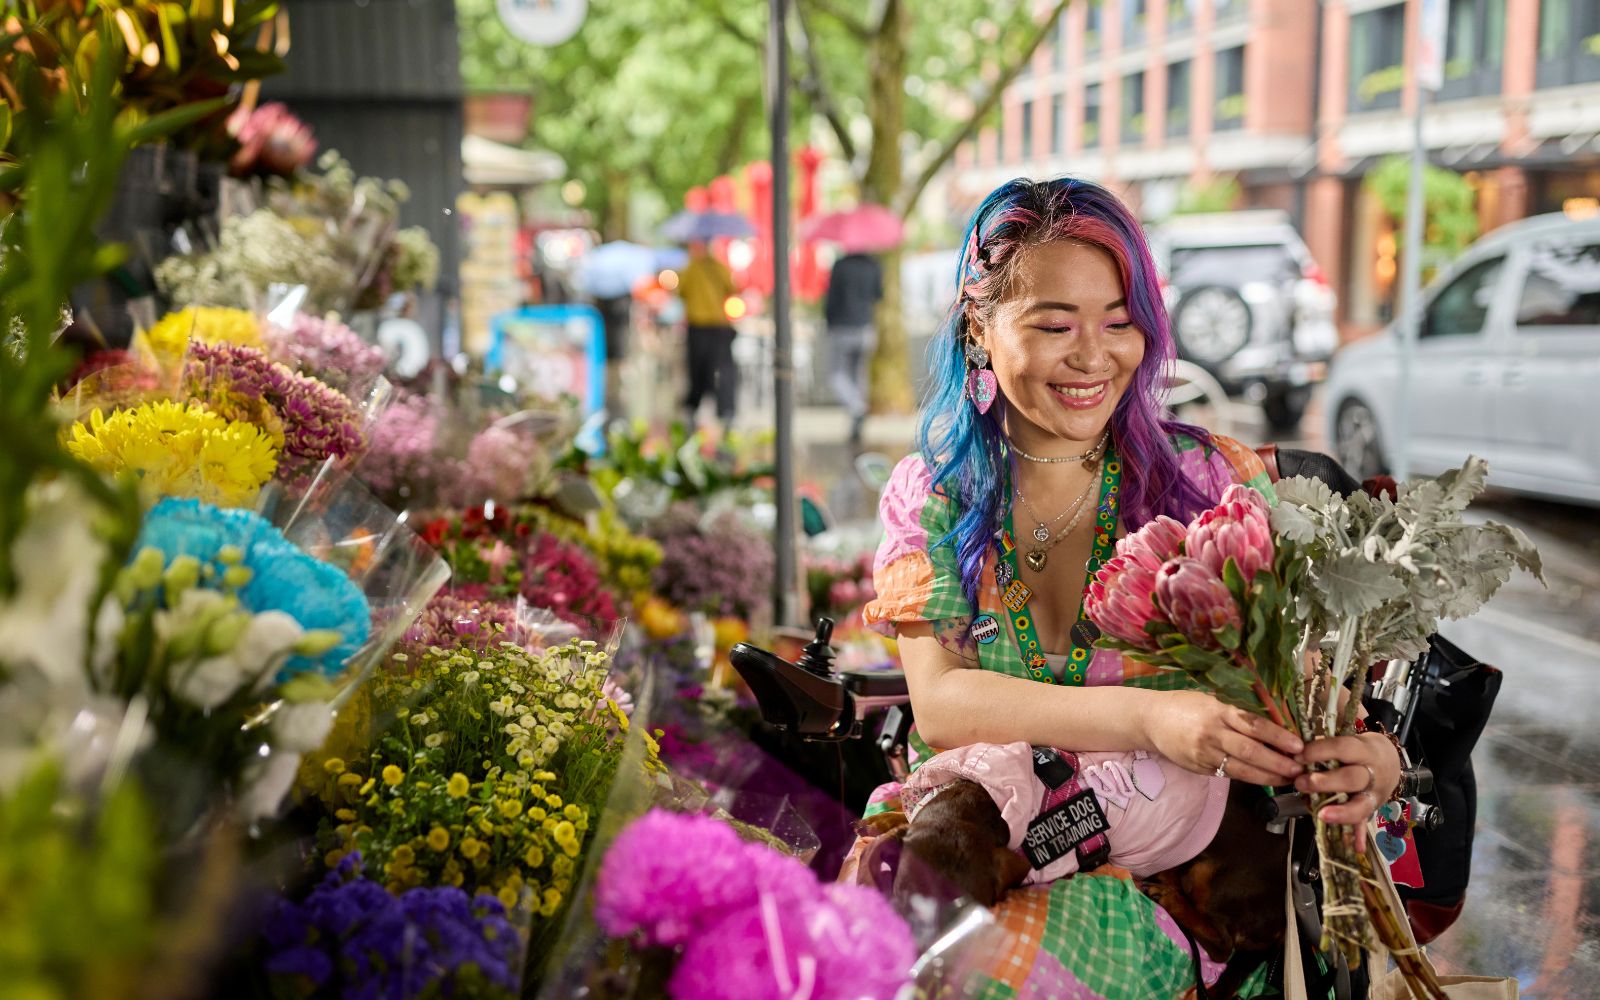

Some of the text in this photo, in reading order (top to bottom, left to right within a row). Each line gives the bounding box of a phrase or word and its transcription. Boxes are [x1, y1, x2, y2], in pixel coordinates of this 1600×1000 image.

[972, 617, 992, 631] THEY
[975, 627, 998, 641] THEM
[1025, 796, 1096, 848] SERVICE DOG
[1033, 813, 1103, 864] IN TRAINING
